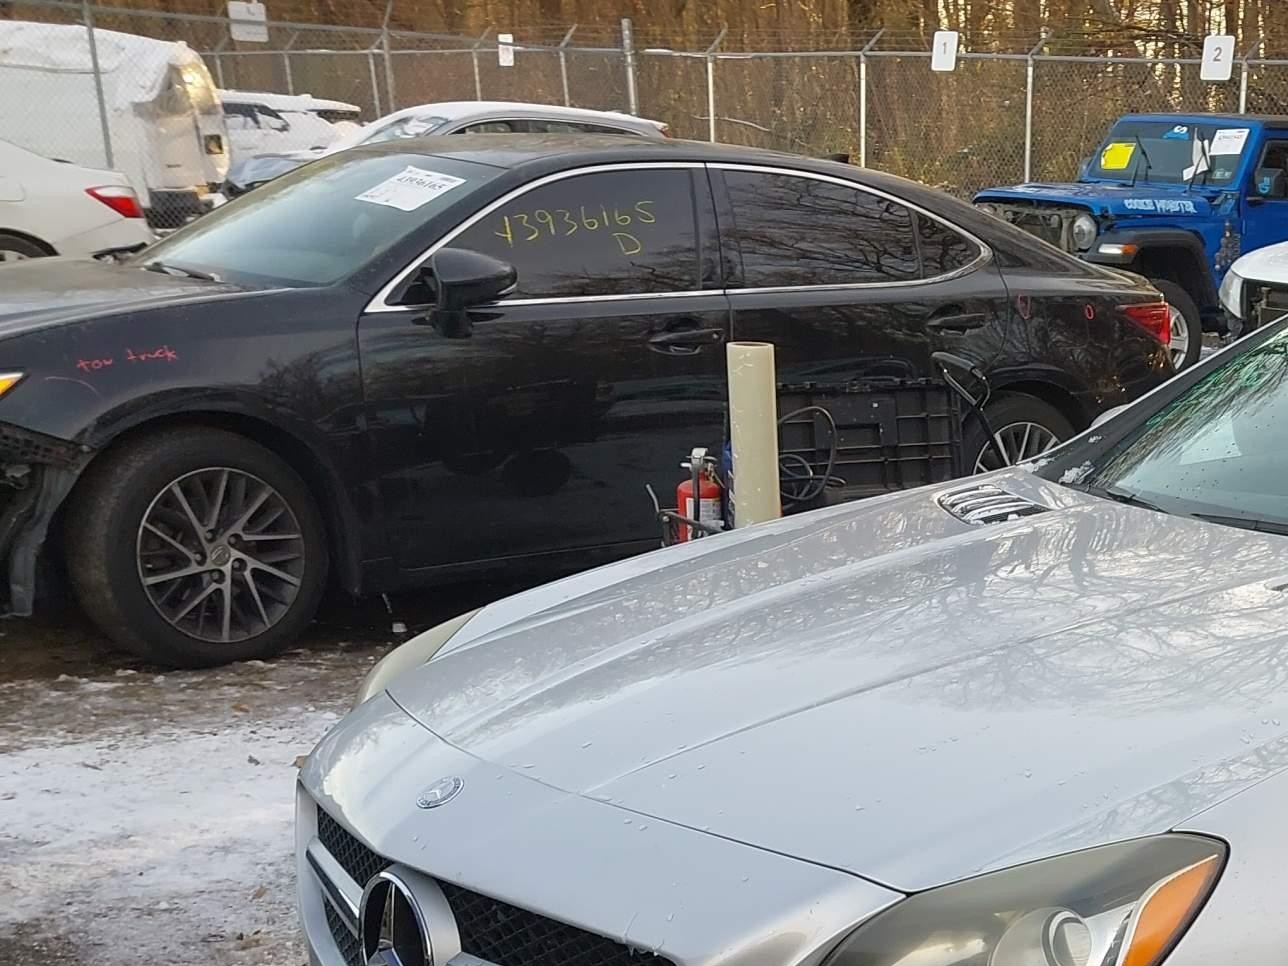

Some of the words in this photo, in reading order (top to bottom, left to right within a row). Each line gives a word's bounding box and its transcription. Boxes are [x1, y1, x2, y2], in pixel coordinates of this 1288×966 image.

[942, 42, 948, 54] 1
[1213, 47, 1222, 62] 2
[612, 232, 641, 255] D
